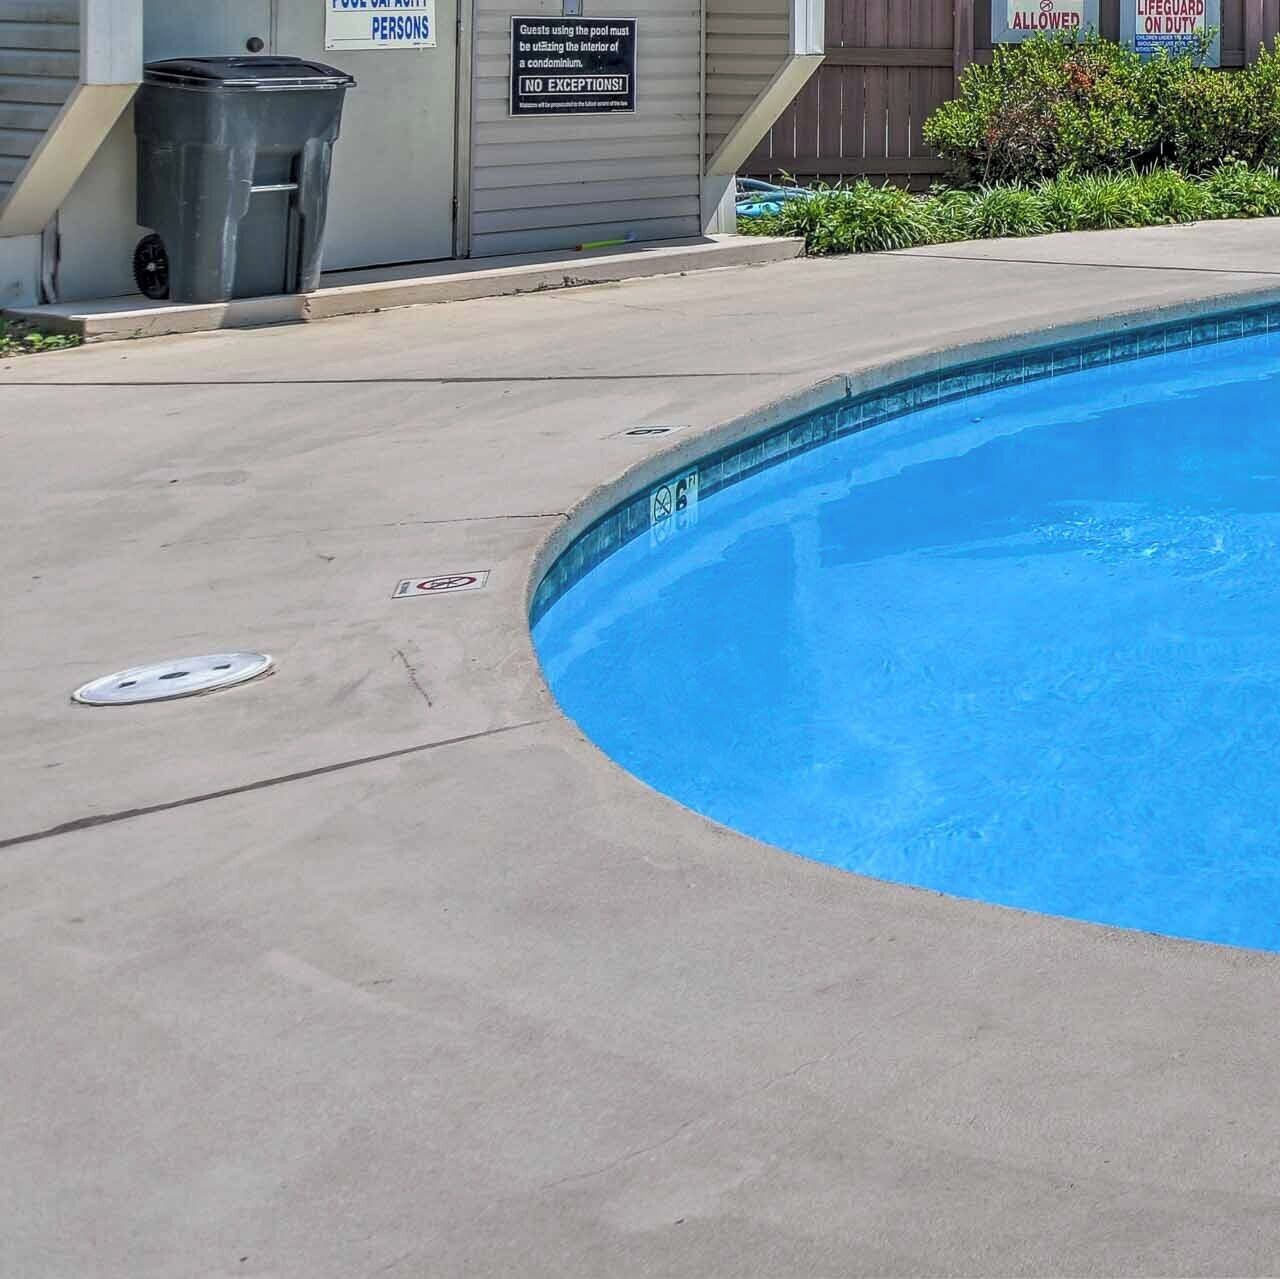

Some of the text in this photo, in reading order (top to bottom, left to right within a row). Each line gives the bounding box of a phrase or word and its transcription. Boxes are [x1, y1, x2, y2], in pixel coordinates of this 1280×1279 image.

[372, 16, 429, 40] PERSONS
[1013, 12, 1080, 30] ALLOWED
[1145, 17, 1196, 33] ON DUTY
[520, 25, 629, 38] Guests using the pool must
[520, 42, 530, 51] be
[566, 42, 578, 51] the
[581, 42, 608, 51] interior
[610, 40, 618, 52] of
[527, 58, 583, 67] condominium.
[526, 79, 623, 92] NO EXCEPTIONS!
[676, 478, 687, 511] 6
